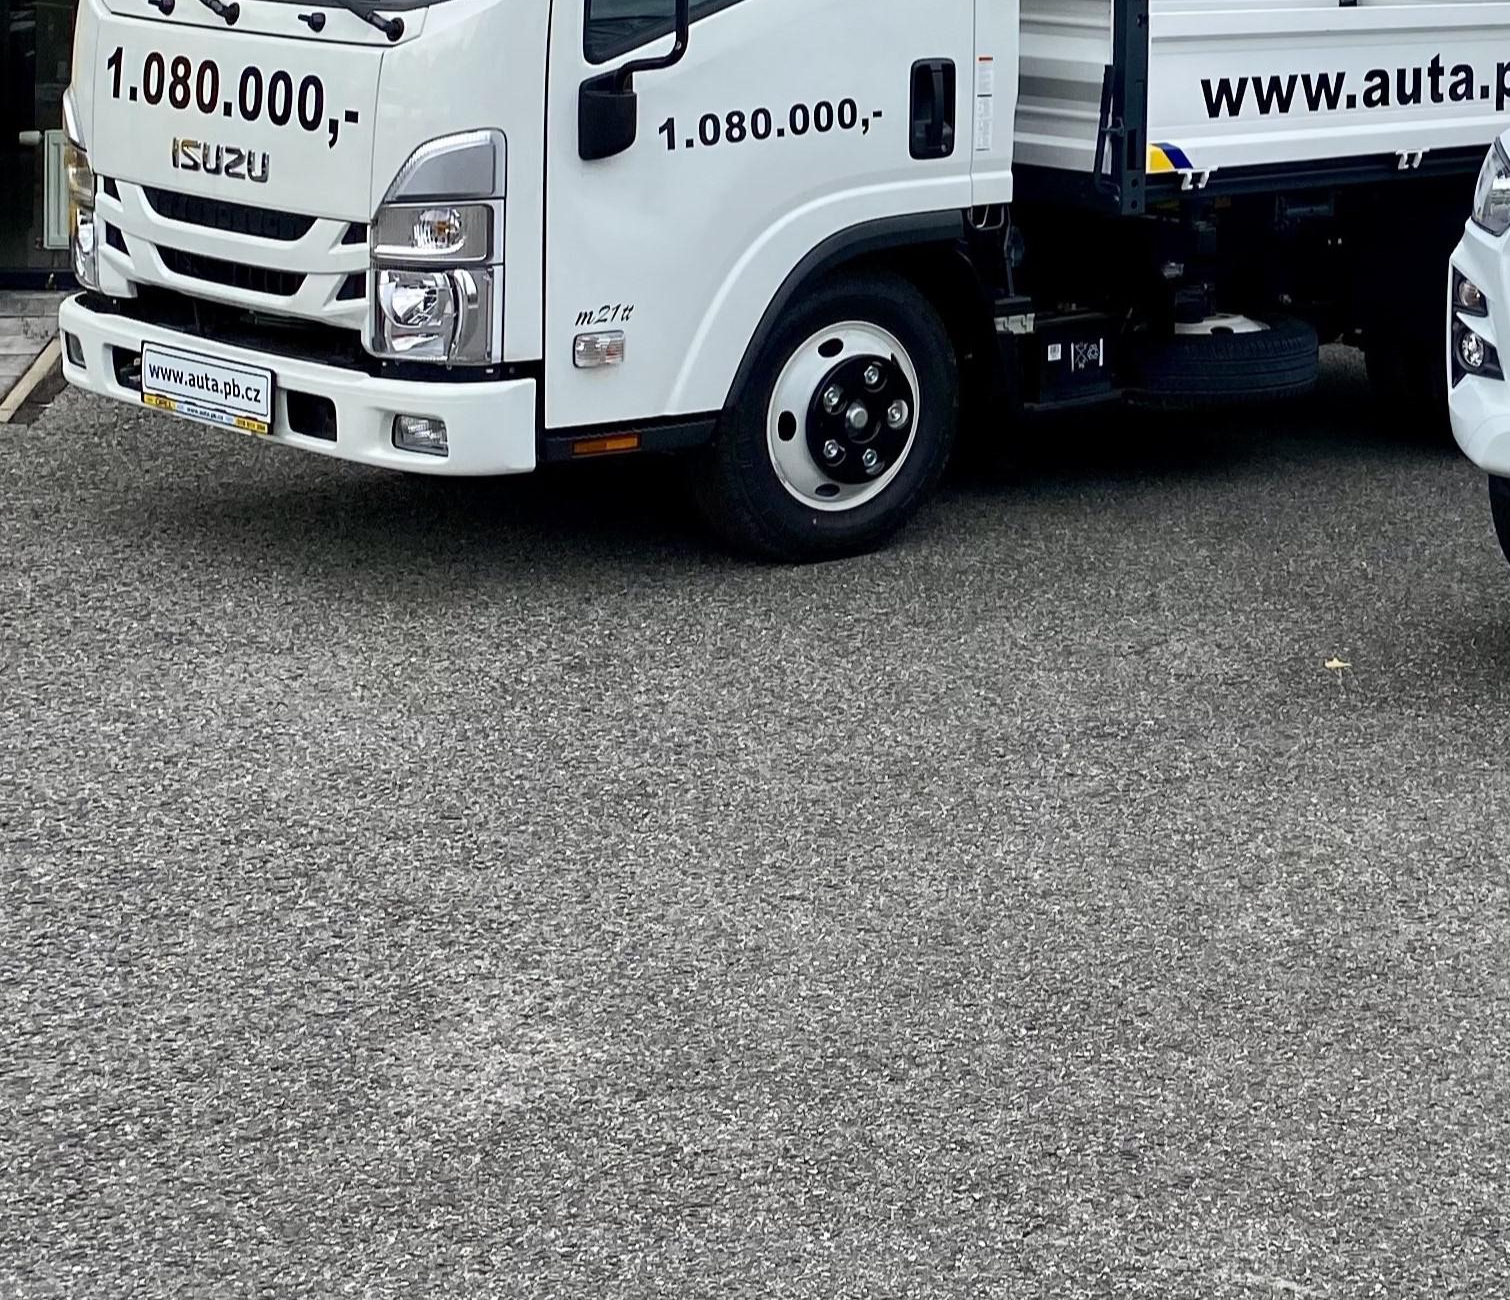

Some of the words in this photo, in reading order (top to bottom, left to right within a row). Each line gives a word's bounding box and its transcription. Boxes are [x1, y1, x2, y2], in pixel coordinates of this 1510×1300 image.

[106, 45, 360, 148] 1.080.000,-
[657, 97, 884, 151] 1.080.000,-
[171, 136, 270, 183] ISUZU
[148, 363, 261, 403] www.auta.pb.cz
